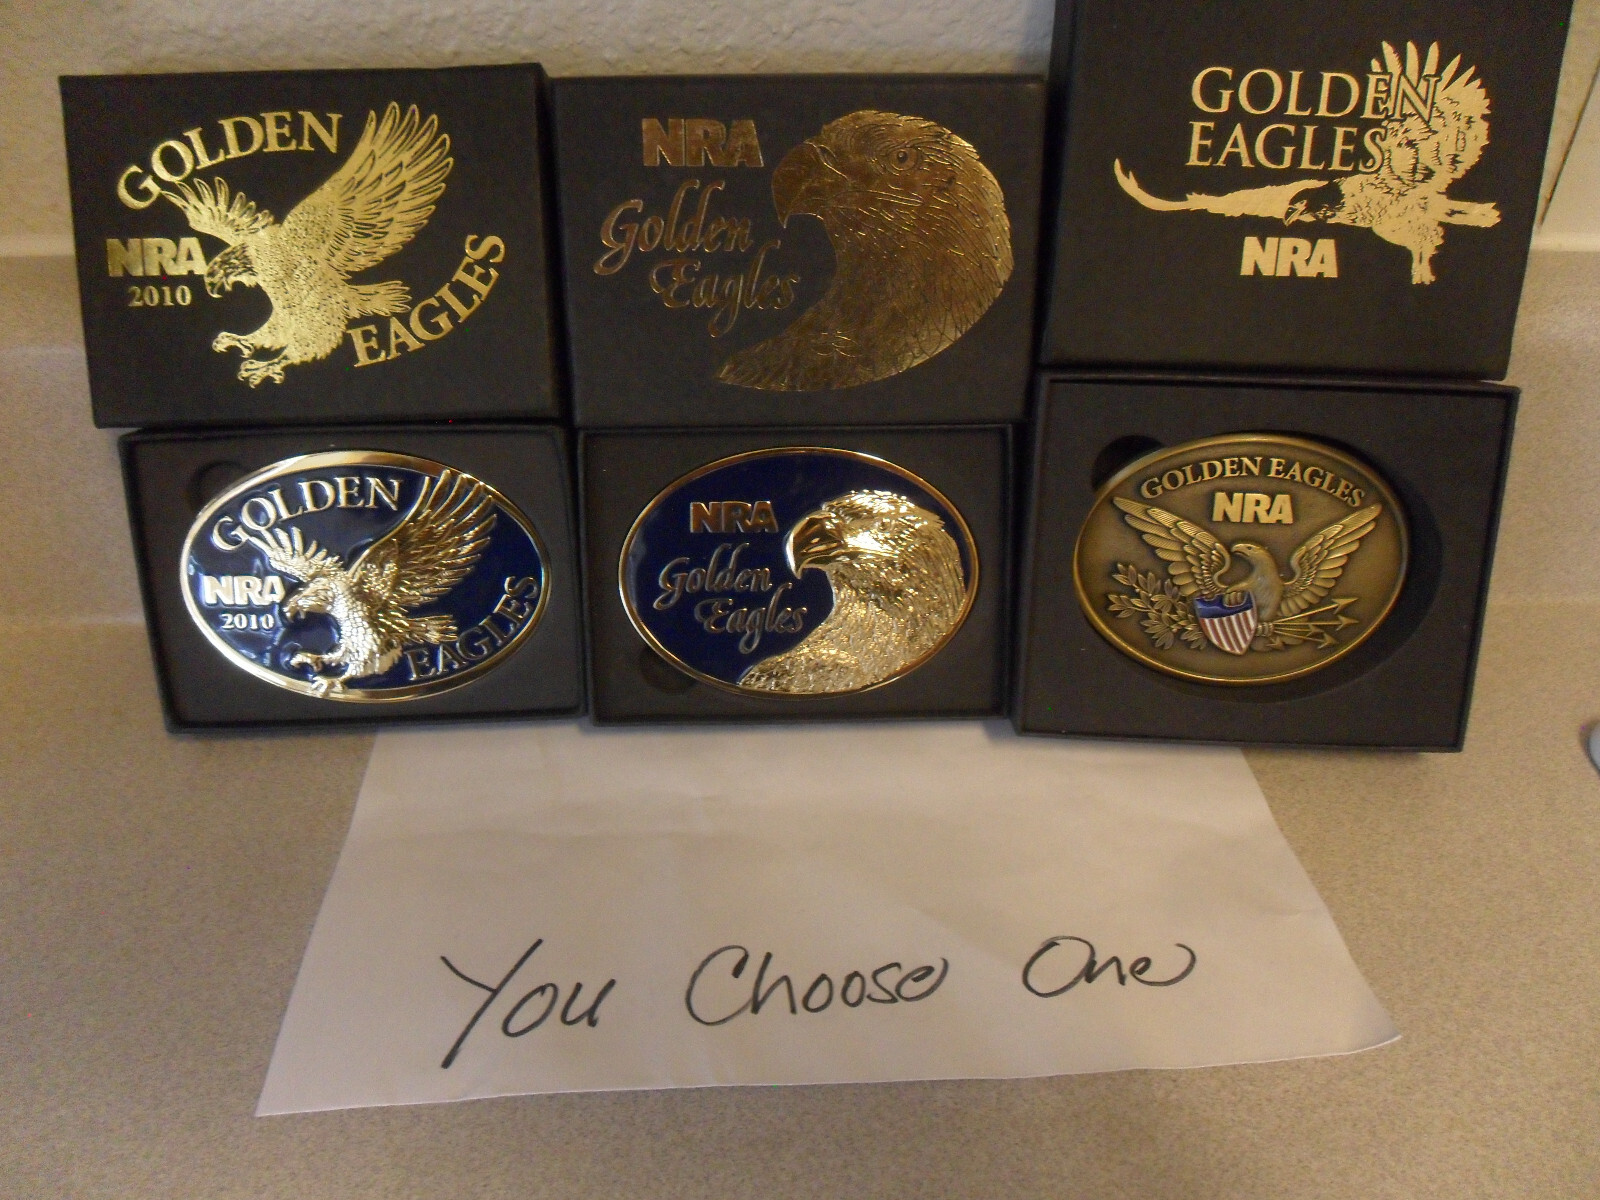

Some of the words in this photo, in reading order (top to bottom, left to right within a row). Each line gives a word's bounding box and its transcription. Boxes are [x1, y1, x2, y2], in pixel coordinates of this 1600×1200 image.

[1191, 67, 1441, 123] GOLDEN
[117, 111, 342, 210] GOLDEN
[642, 118, 764, 167] NRA
[1186, 121, 1387, 174] EAGLES
[593, 179, 753, 275] Golden
[106, 237, 207, 277] NRA
[1240, 236, 1338, 278] NRA
[129, 285, 191, 307] 2010
[347, 234, 505, 367] EAGLES
[650, 240, 799, 338] Eagles
[1141, 456, 1263, 500] GOLDEN
[1267, 458, 1366, 507] EAGLES
[1212, 492, 1294, 524] NRA
[212, 477, 404, 551] GOLDEN
[690, 501, 779, 534] NRA
[203, 575, 285, 606] NRA
[652, 542, 773, 611] Golden
[222, 613, 274, 630] 2010
[405, 576, 538, 680] EAGLES
[694, 582, 807, 654] Eagles
[441, 939, 617, 1070] You
[684, 944, 950, 1026] Choose
[1021, 935, 1196, 998] One
